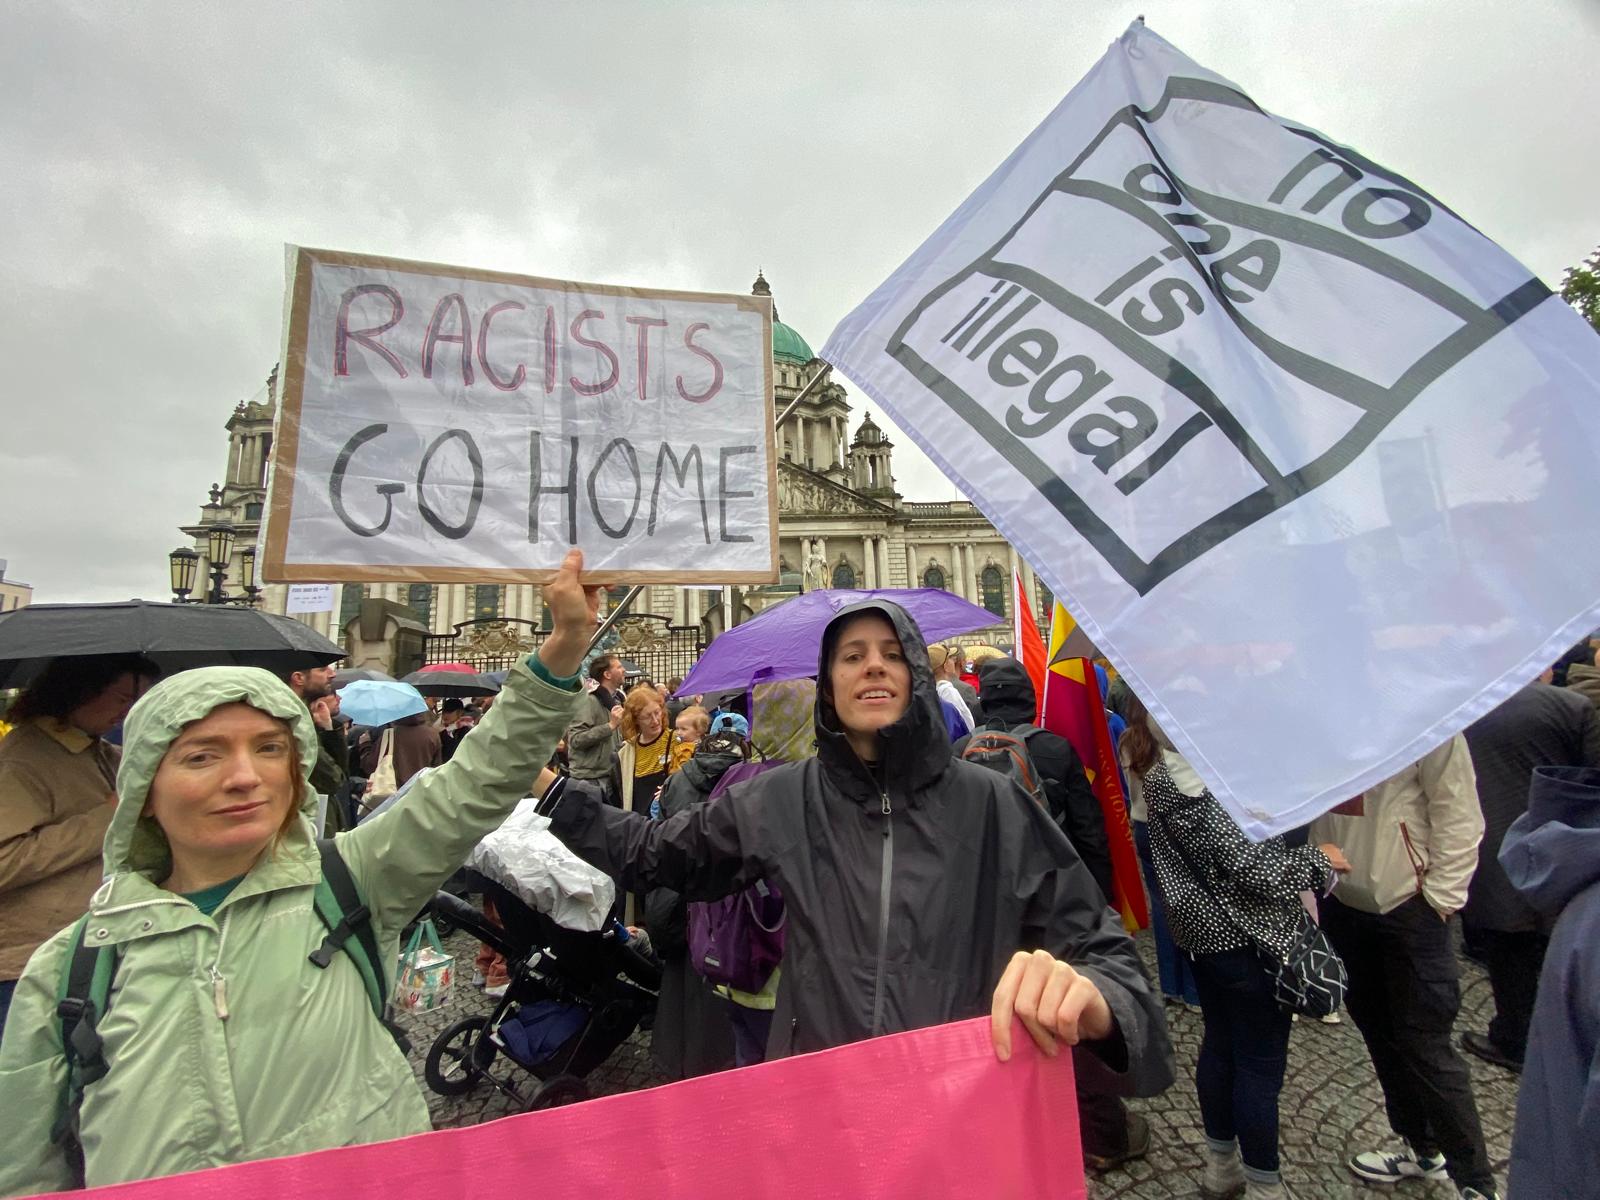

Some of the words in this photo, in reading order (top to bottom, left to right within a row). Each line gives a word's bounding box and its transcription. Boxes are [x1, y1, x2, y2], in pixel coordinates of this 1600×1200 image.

[1123, 163, 1281, 303] one
[1267, 148, 1432, 239] no
[334, 284, 724, 403] RACISTS
[1094, 245, 1205, 336] is
[940, 280, 1214, 496] illegal
[329, 424, 485, 539] GO
[528, 430, 757, 545] HOME
